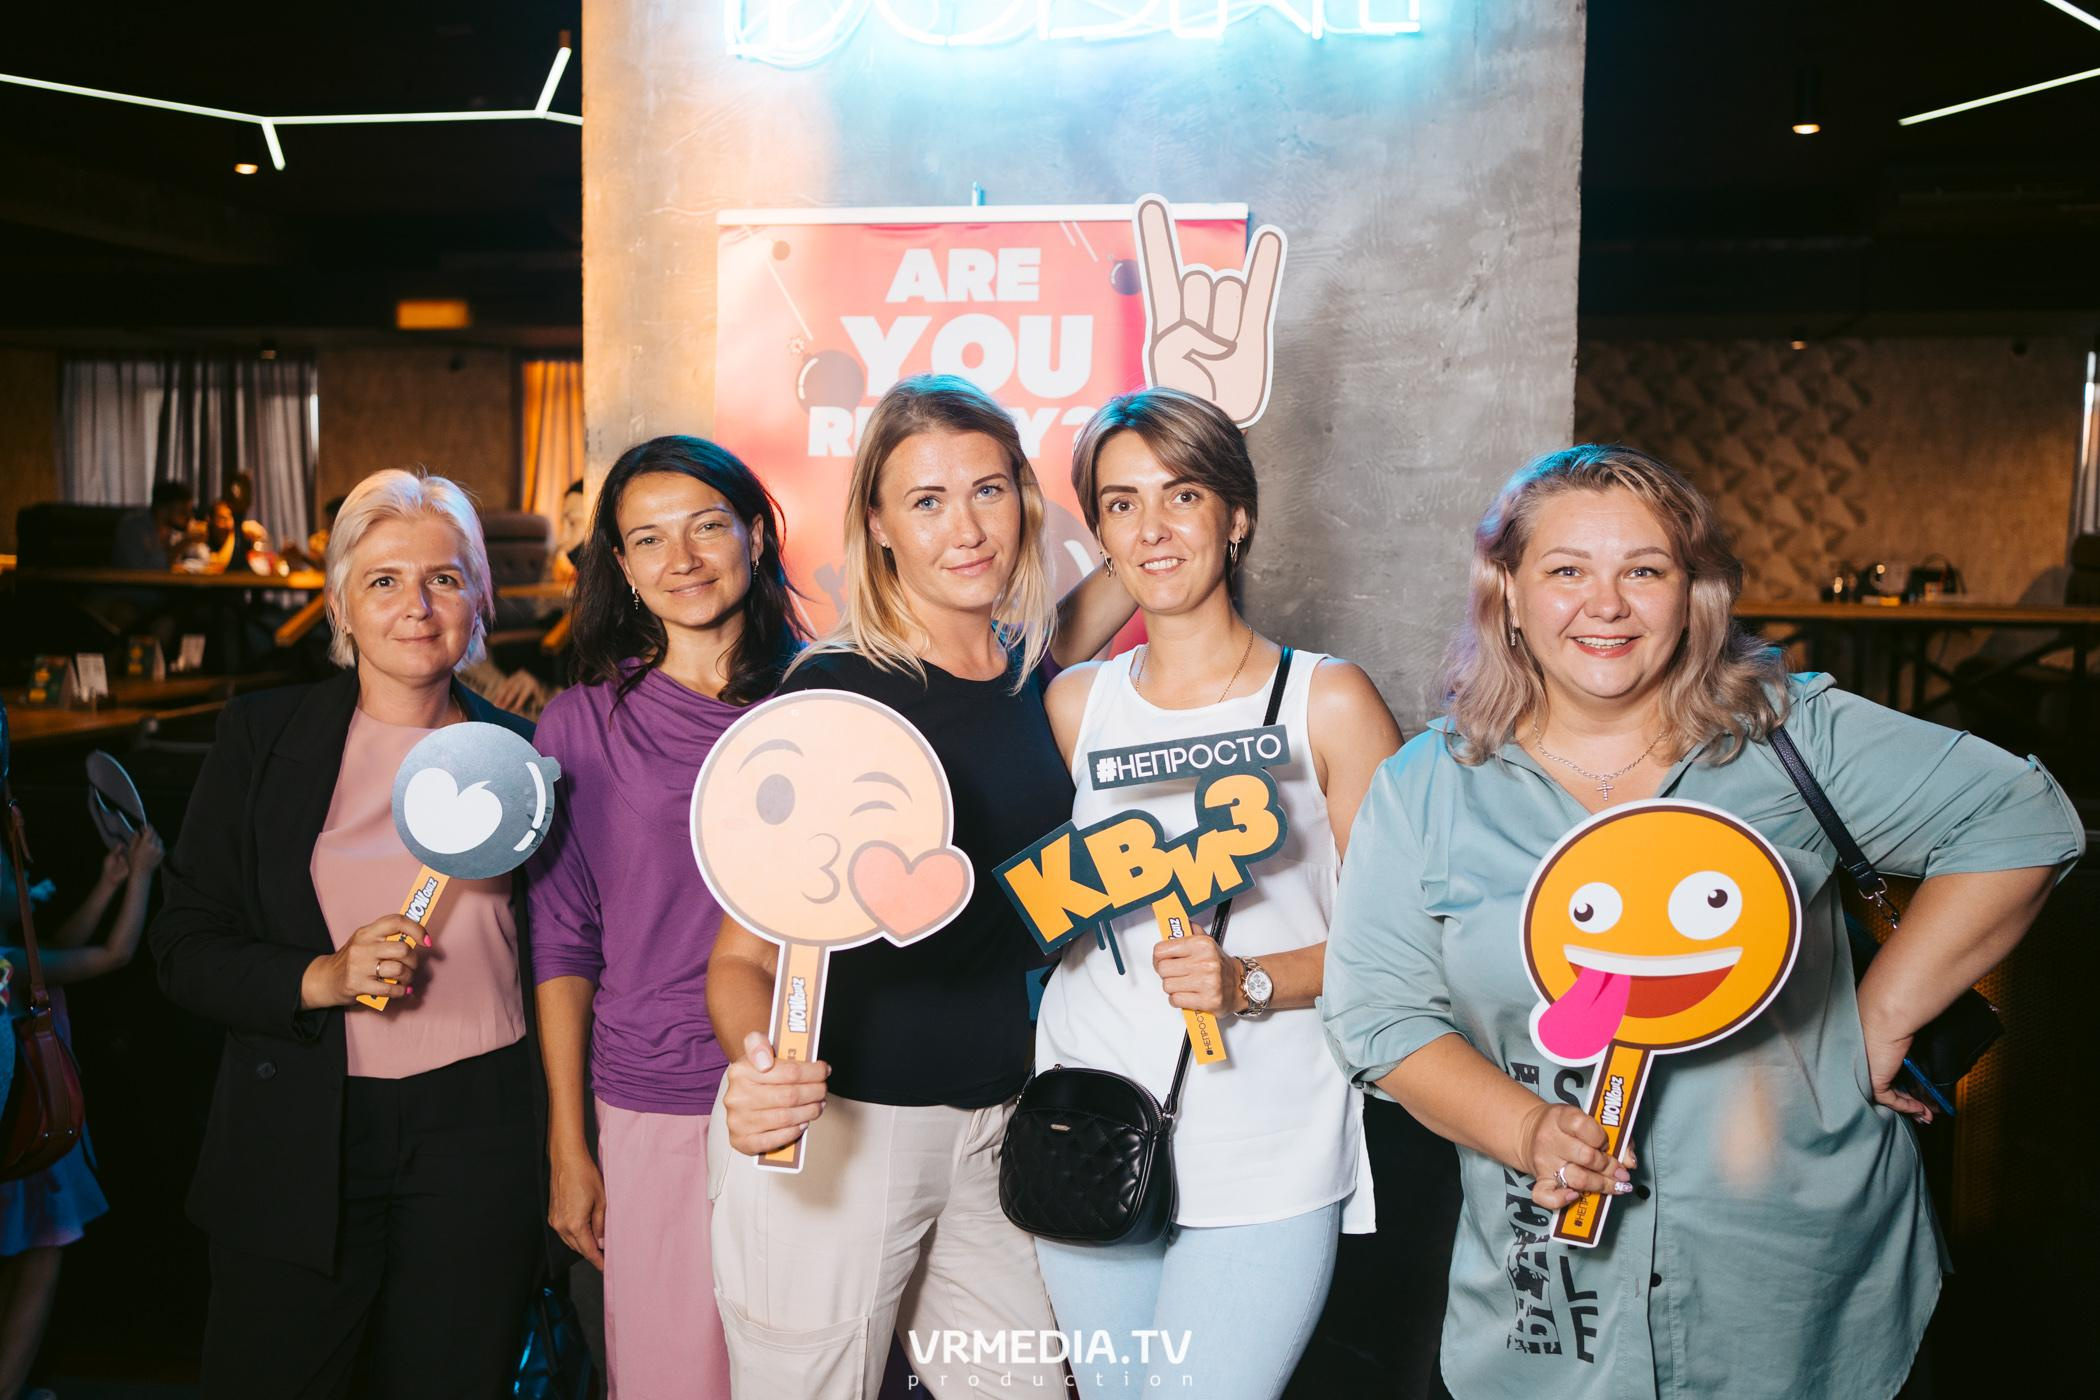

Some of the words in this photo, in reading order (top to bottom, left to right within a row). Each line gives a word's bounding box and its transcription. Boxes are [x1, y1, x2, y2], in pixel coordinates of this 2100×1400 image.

[885, 248, 1041, 303] ARE
[839, 313, 1094, 399] YOU
[1096, 733, 1282, 783] #НЕПРОСТО
